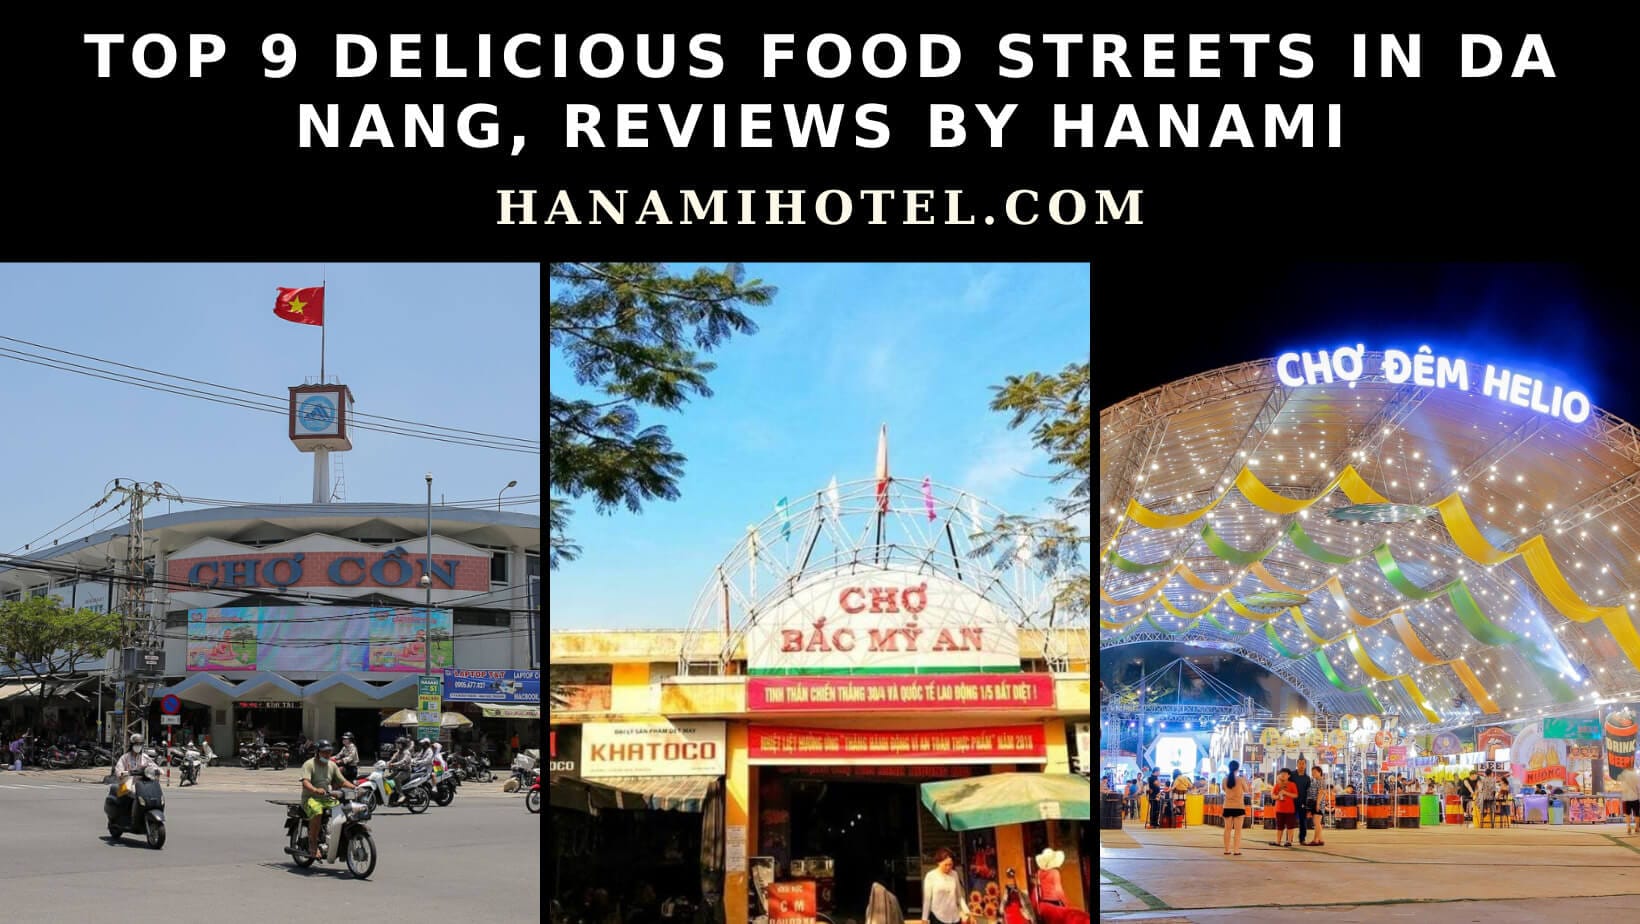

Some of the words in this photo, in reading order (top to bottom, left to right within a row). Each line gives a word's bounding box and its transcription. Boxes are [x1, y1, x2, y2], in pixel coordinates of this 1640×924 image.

[1277, 344, 1365, 388] CHỢ
[1381, 345, 1469, 391] ĐÊM
[1482, 364, 1590, 424] HELIO
[188, 553, 305, 592] CHỢ
[839, 583, 928, 621] CHỢ
[781, 617, 856, 652] BẮC
[868, 622, 922, 652] MỸ
[932, 627, 983, 652] AN
[591, 742, 716, 761] KHATOCO
[1606, 738, 1635, 753] DRINK
